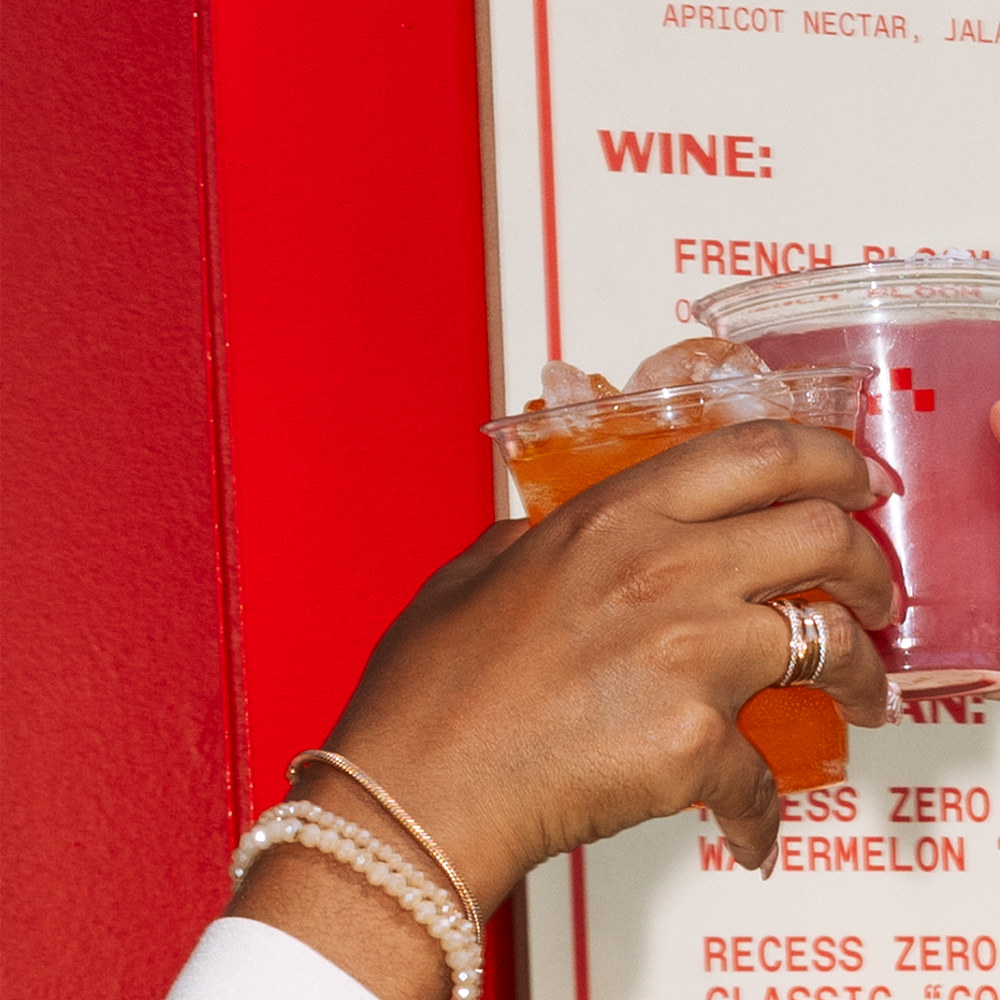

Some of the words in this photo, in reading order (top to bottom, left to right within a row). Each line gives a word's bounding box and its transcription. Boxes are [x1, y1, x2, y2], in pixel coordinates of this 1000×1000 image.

[662, 3, 785, 34] APRICOT
[802, 10, 921, 43] NECTAR,
[598, 129, 774, 179] WINE:
[674, 238, 834, 277] FRENCH
[889, 786, 992, 823] ZERO
[698, 836, 967, 873] WERMELON
[703, 935, 865, 973] RECESS
[894, 935, 998, 972] ZERO
